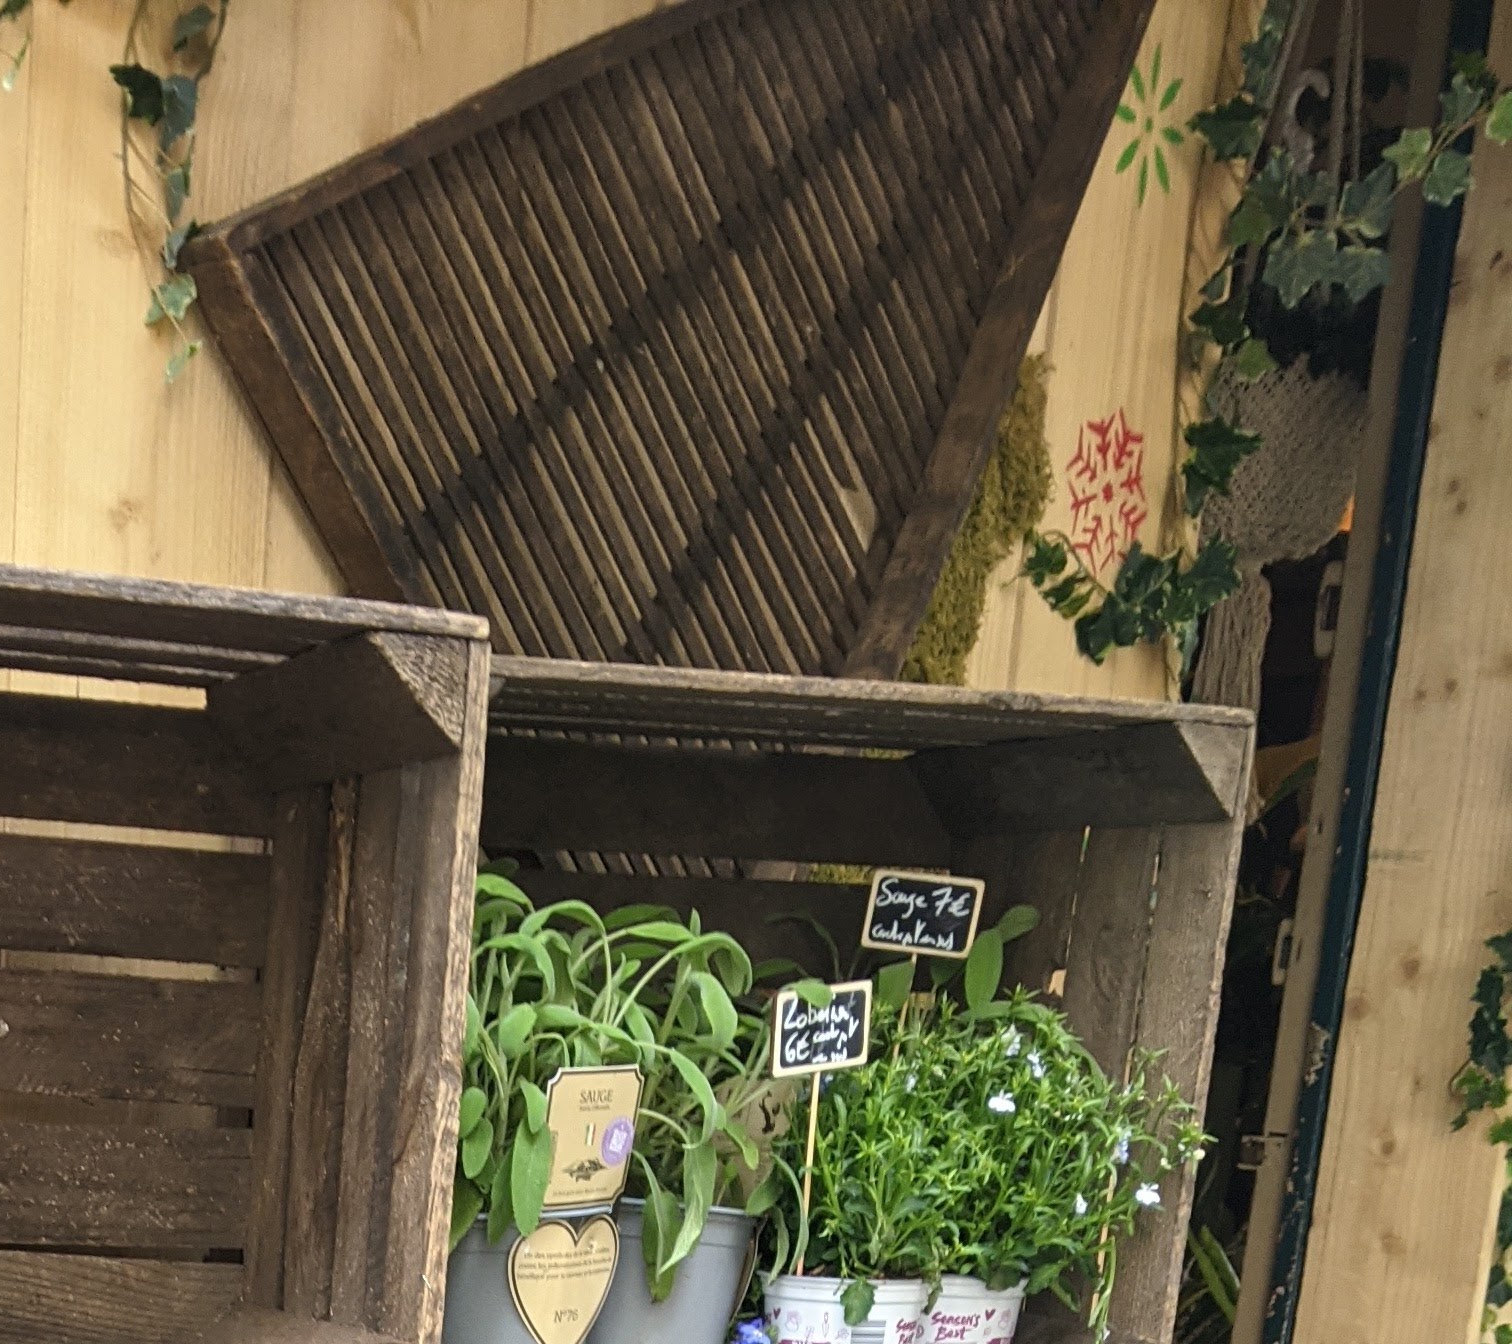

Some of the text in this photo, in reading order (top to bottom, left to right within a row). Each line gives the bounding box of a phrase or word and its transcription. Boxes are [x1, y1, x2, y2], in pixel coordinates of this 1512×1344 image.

[931, 886, 971, 917] 7€
[579, 1088, 614, 1105] SAUGE
[931, 1311, 981, 1329] Season's
[934, 1326, 972, 1343] Best
